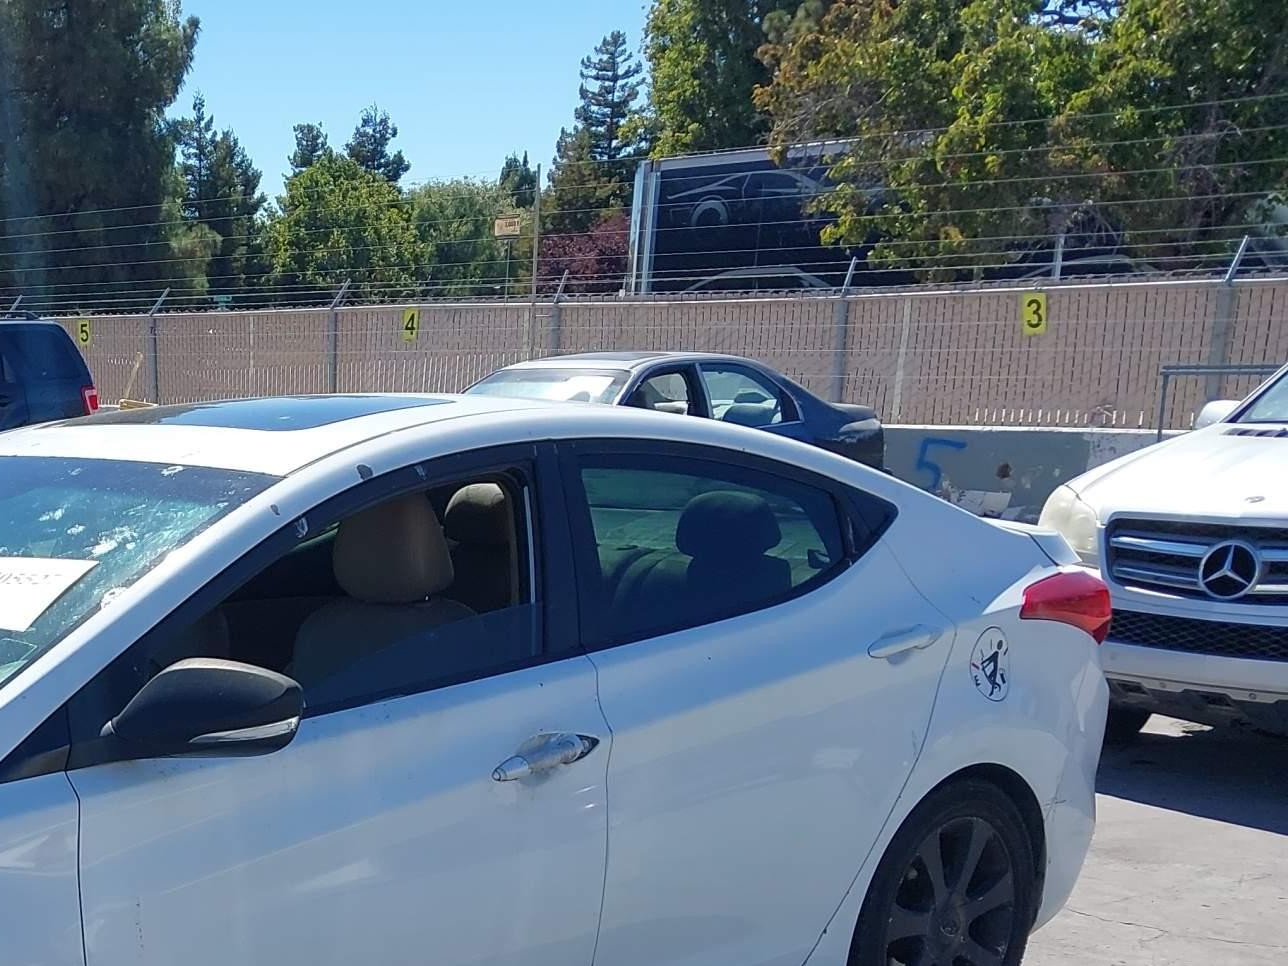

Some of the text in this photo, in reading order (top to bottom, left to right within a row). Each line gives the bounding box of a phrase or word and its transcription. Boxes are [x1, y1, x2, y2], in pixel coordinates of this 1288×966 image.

[405, 312, 416, 336] 4
[1027, 298, 1043, 329] 3
[80, 323, 89, 342] 5
[915, 436, 968, 491] 5
